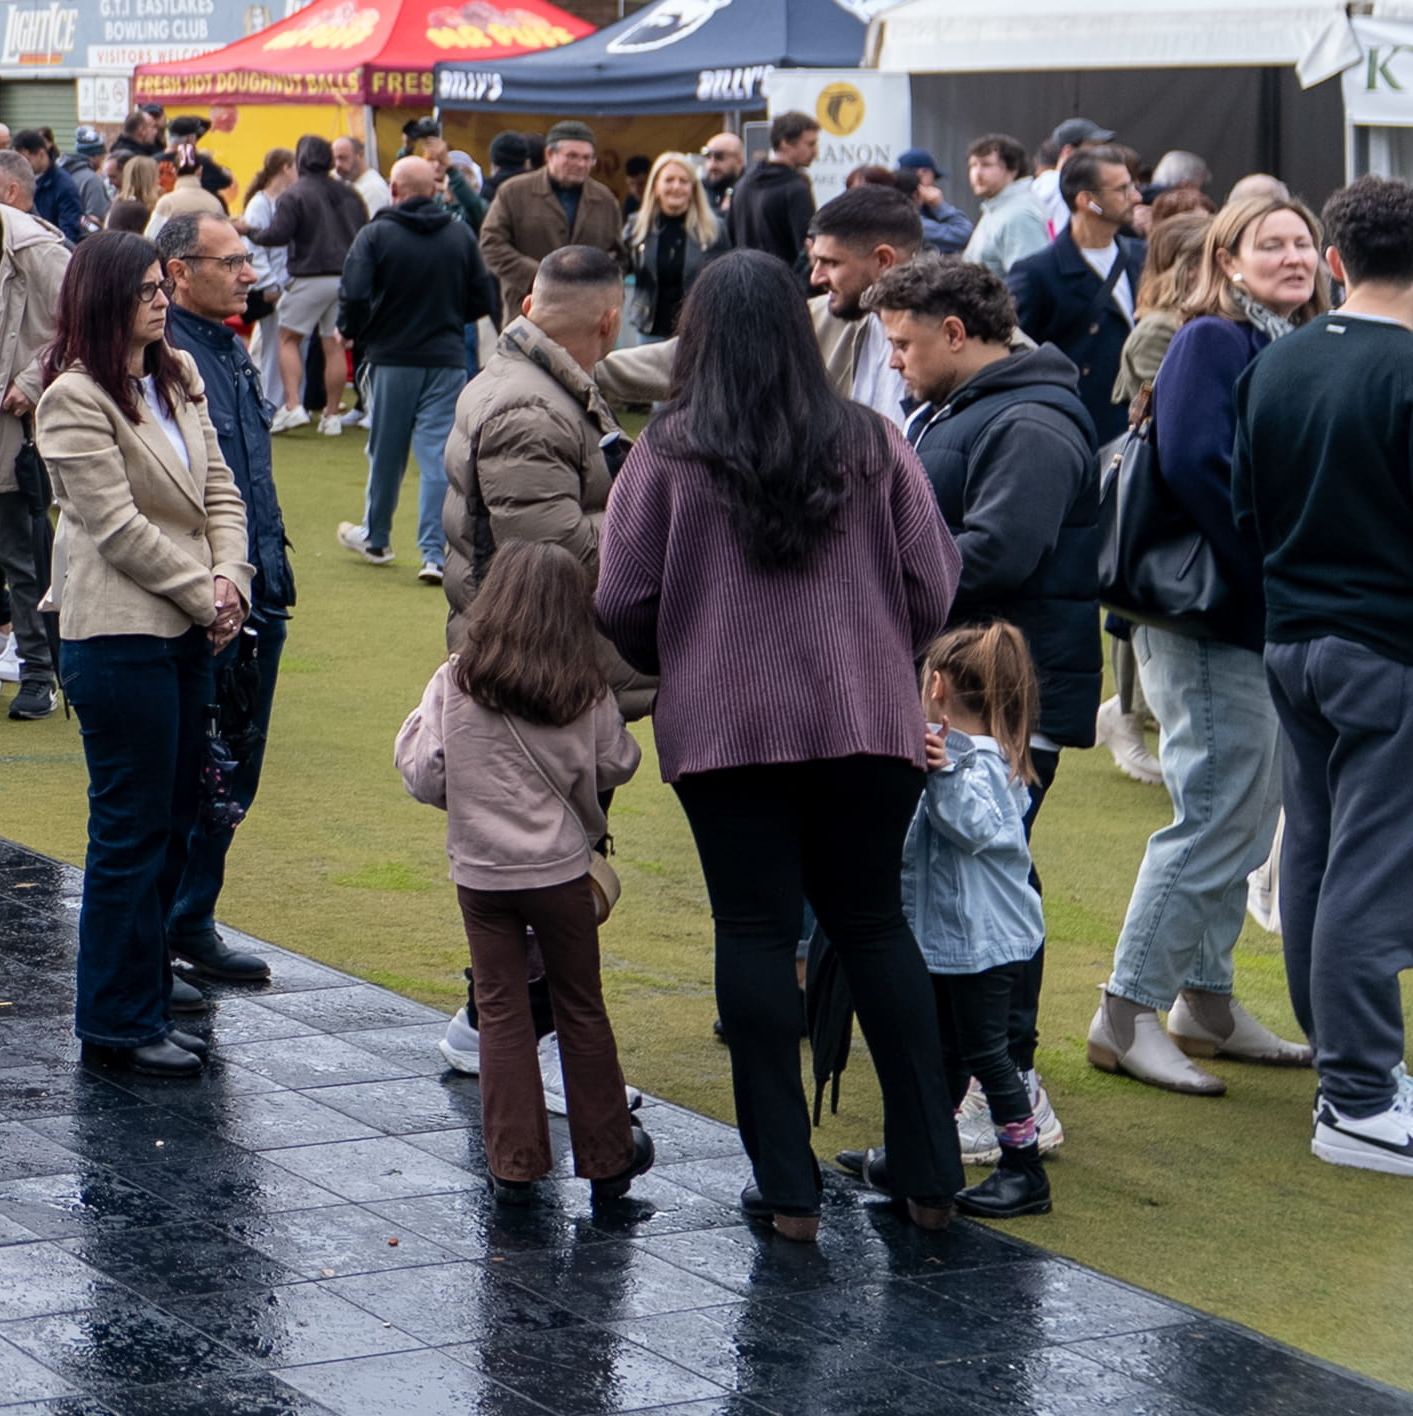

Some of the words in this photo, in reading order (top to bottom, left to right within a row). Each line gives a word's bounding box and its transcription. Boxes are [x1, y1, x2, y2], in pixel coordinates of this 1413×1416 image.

[104, 20, 169, 41] BOWLING
[172, 18, 209, 40] CLUB
[96, 48, 153, 64] VISITORS
[305, 70, 359, 94] BALLS
